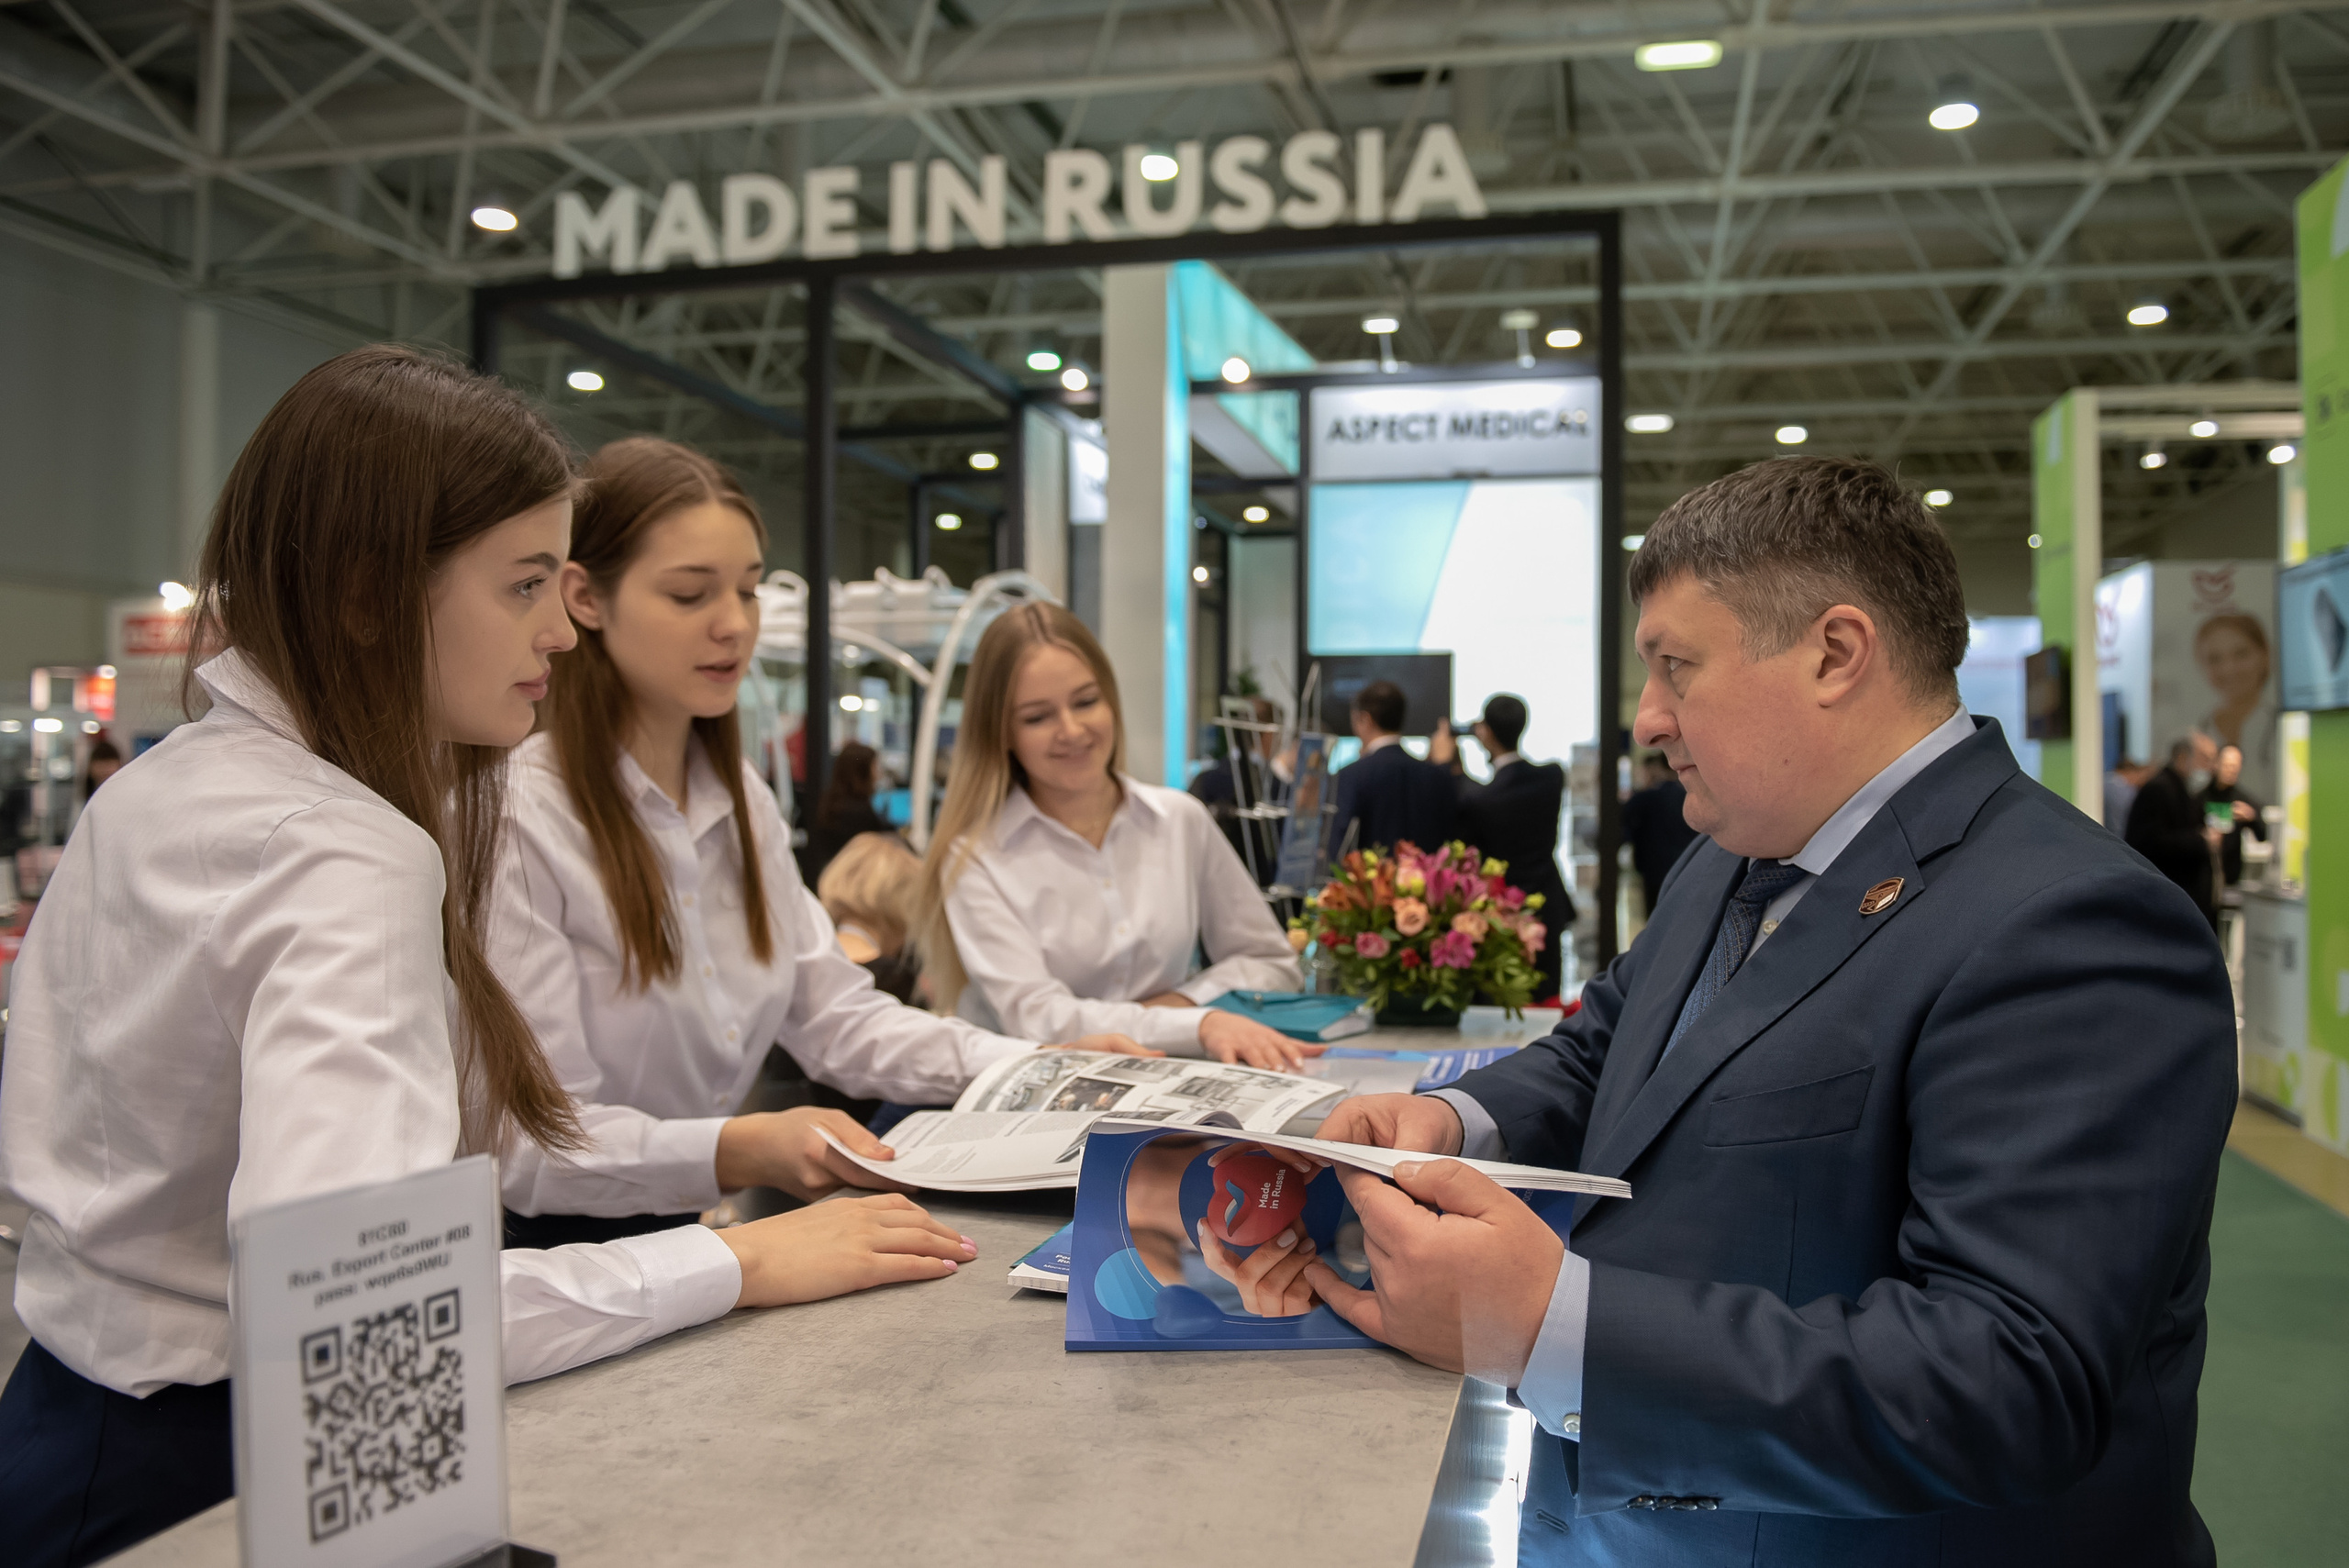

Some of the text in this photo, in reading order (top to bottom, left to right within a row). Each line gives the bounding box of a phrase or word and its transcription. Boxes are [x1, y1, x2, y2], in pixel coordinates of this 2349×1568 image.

[553, 123, 1487, 280] MADE IN RUSSIA
[1328, 413, 1438, 443] ASPECT
[1258, 1182, 1271, 1208] Made
[1269, 1169, 1286, 1209] in Russia
[331, 1251, 385, 1278] Export
[390, 1236, 441, 1260] Center
